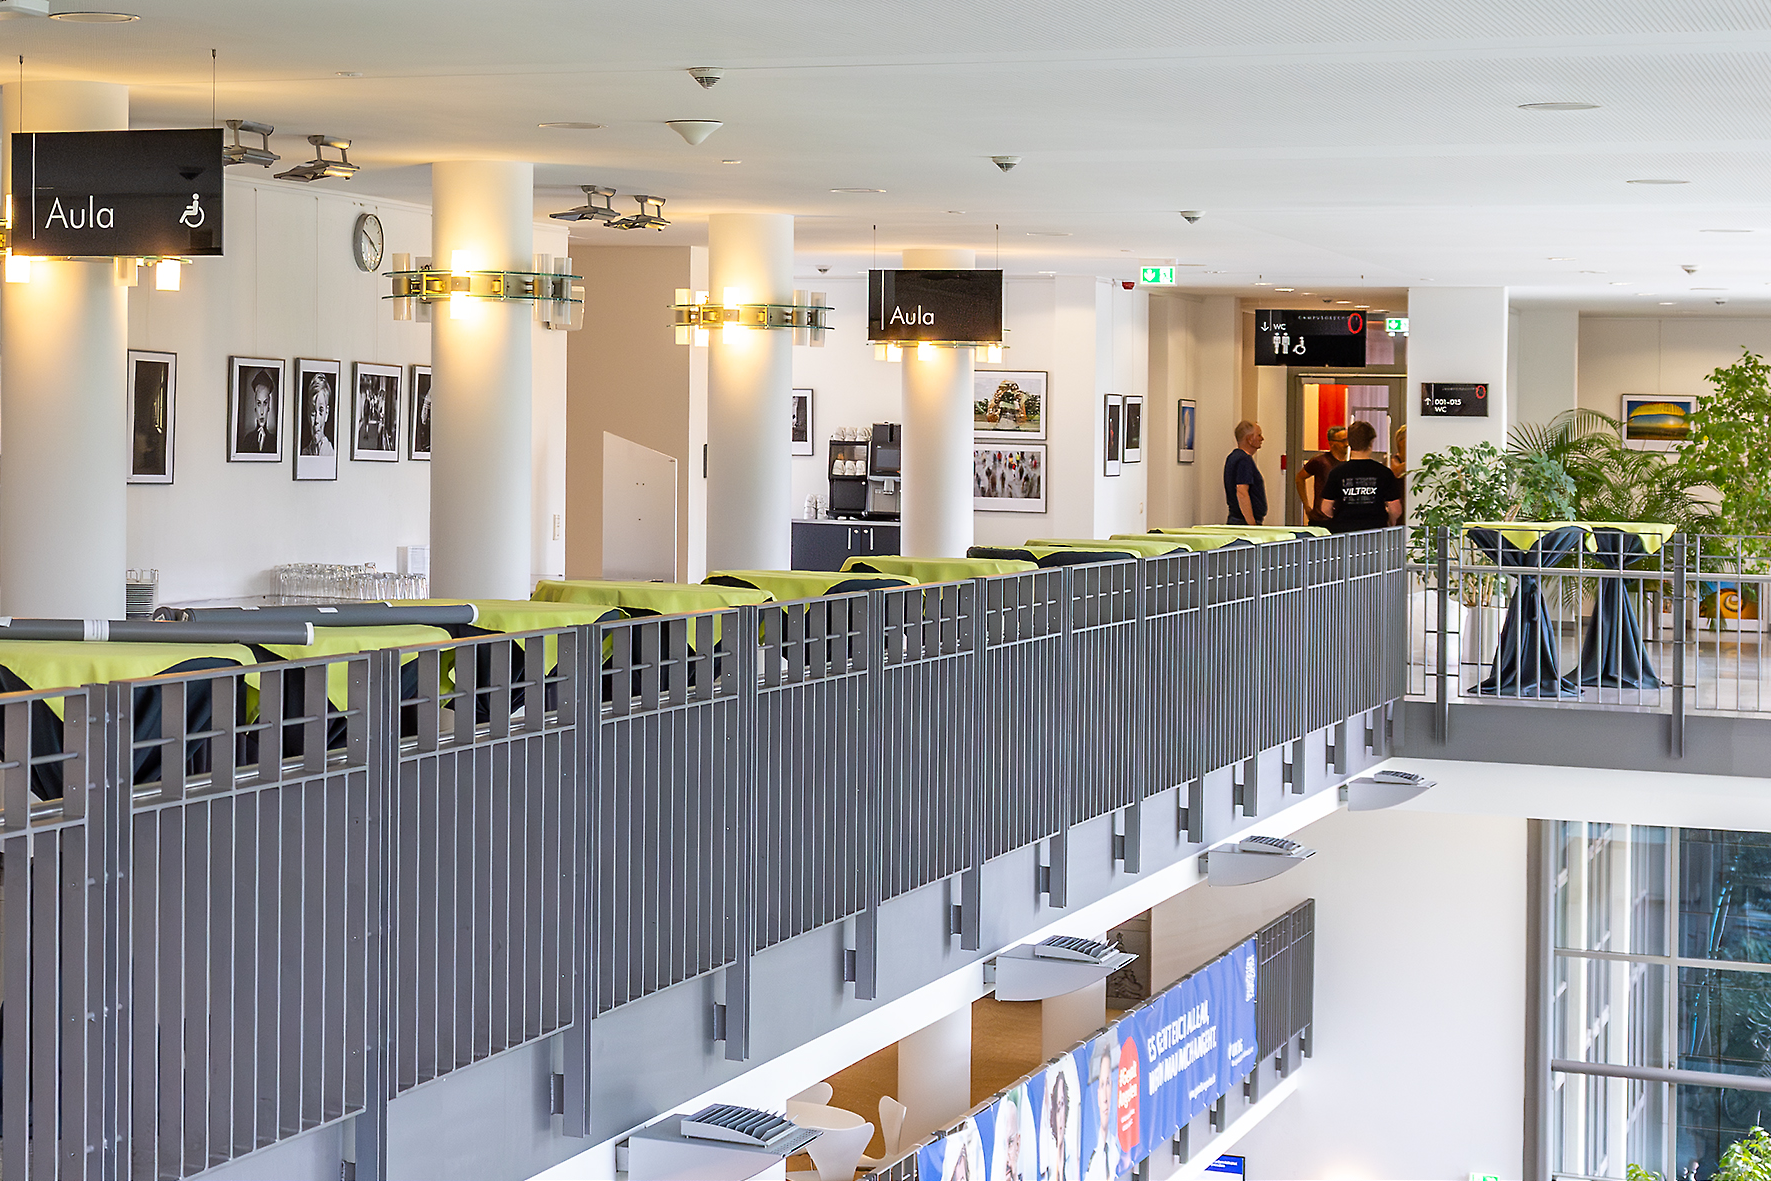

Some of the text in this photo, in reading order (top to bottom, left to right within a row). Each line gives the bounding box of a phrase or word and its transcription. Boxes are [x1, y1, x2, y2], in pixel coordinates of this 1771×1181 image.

[44, 195, 115, 230] Aula
[889, 304, 935, 325] Aula
[1273, 323, 1287, 331] WC
